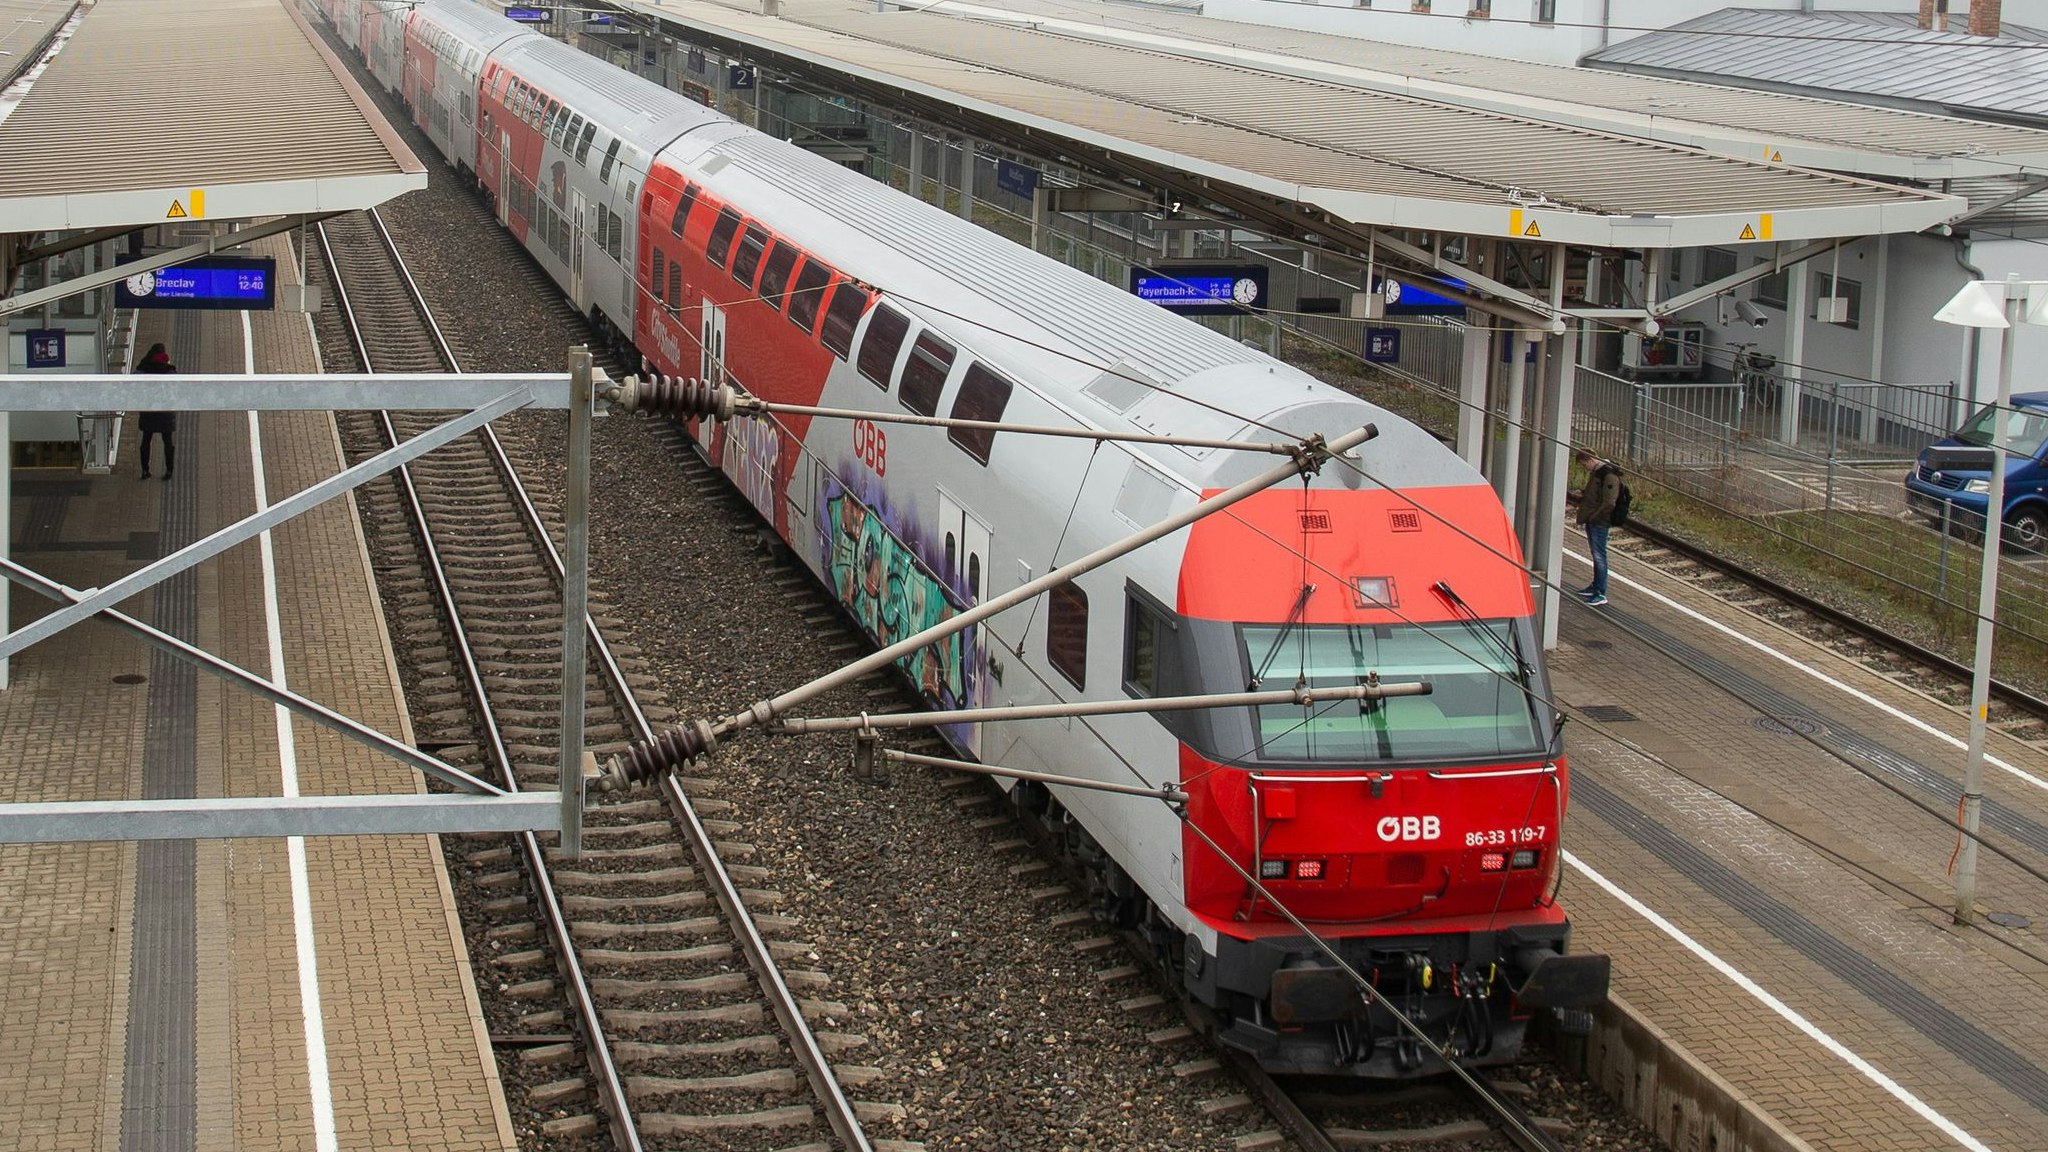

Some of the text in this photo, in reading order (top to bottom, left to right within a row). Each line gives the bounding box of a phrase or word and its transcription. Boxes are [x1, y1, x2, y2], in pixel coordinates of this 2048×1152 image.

[736, 69, 748, 86] 2
[155, 278, 195, 288] Breclav
[853, 417, 886, 478] ÖBB
[1376, 815, 1441, 842] ÖBB
[1465, 825, 1546, 847] 86-33 119-7
